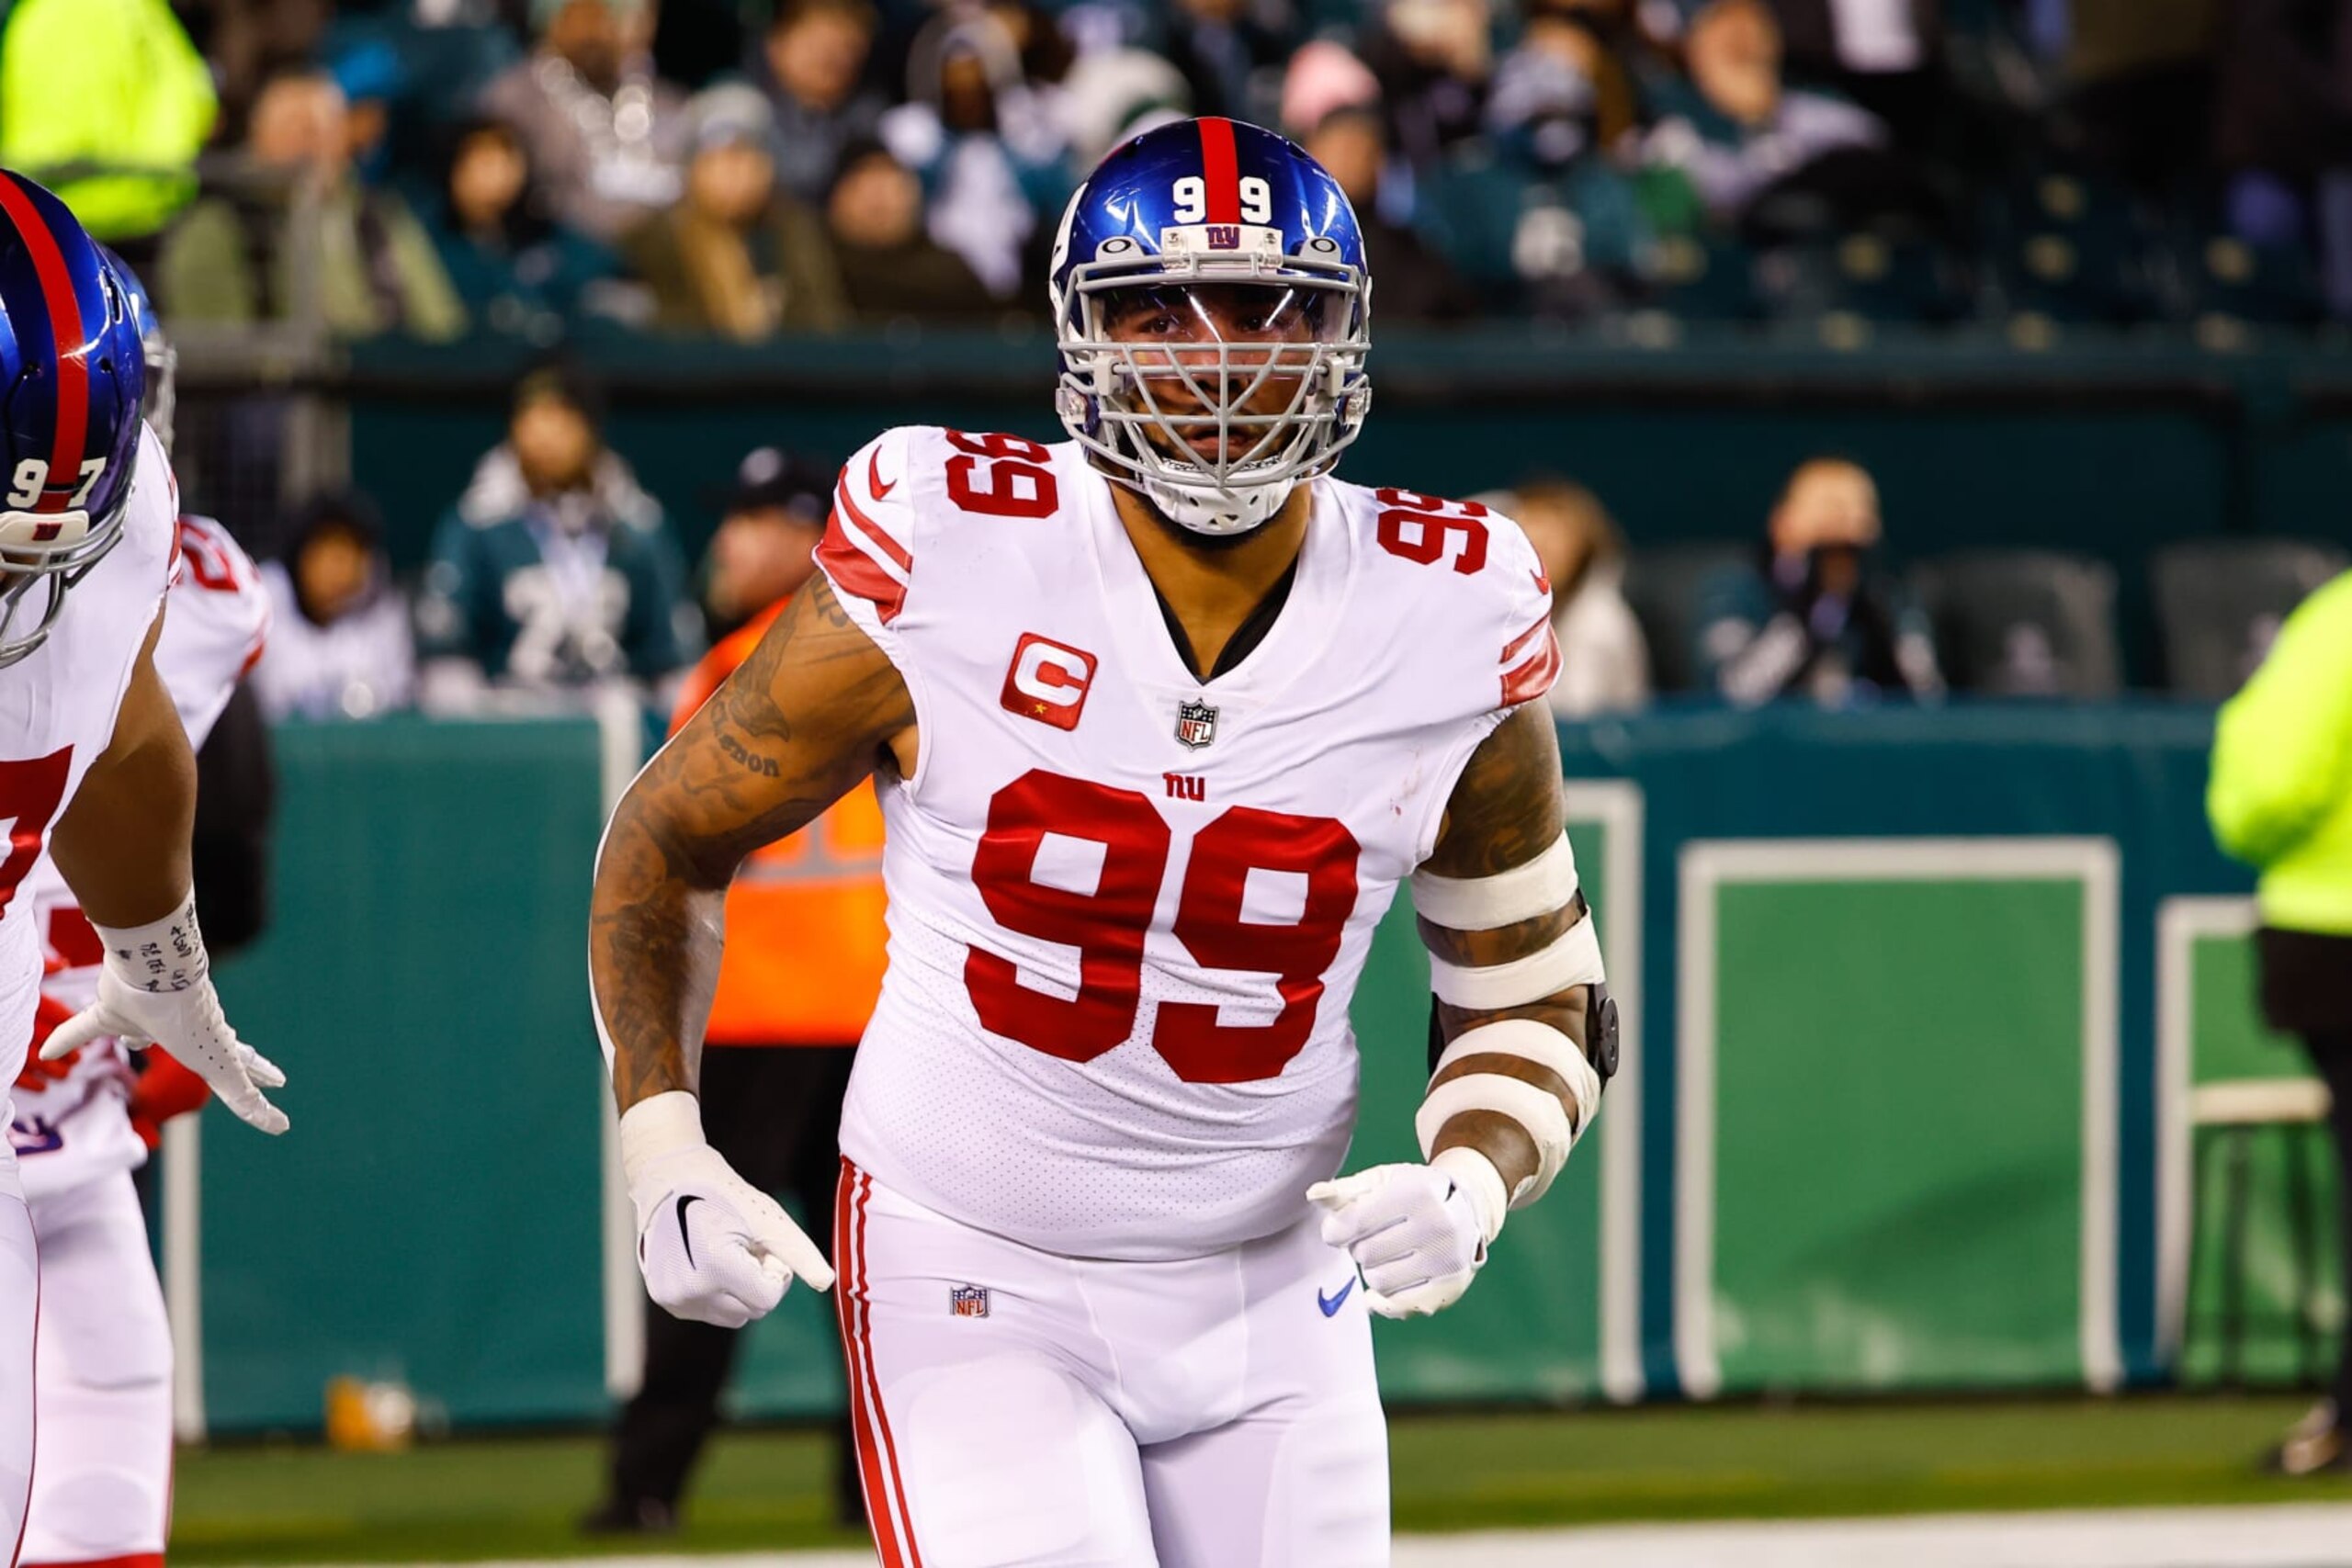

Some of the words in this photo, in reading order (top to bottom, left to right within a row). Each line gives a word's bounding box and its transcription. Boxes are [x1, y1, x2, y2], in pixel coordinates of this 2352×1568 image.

[6, 457, 107, 508] 97
[1013, 641, 1088, 707] C
[1182, 720, 1210, 741] NFL
[964, 768, 1362, 1083] 99
[956, 1300, 984, 1316] NFL
